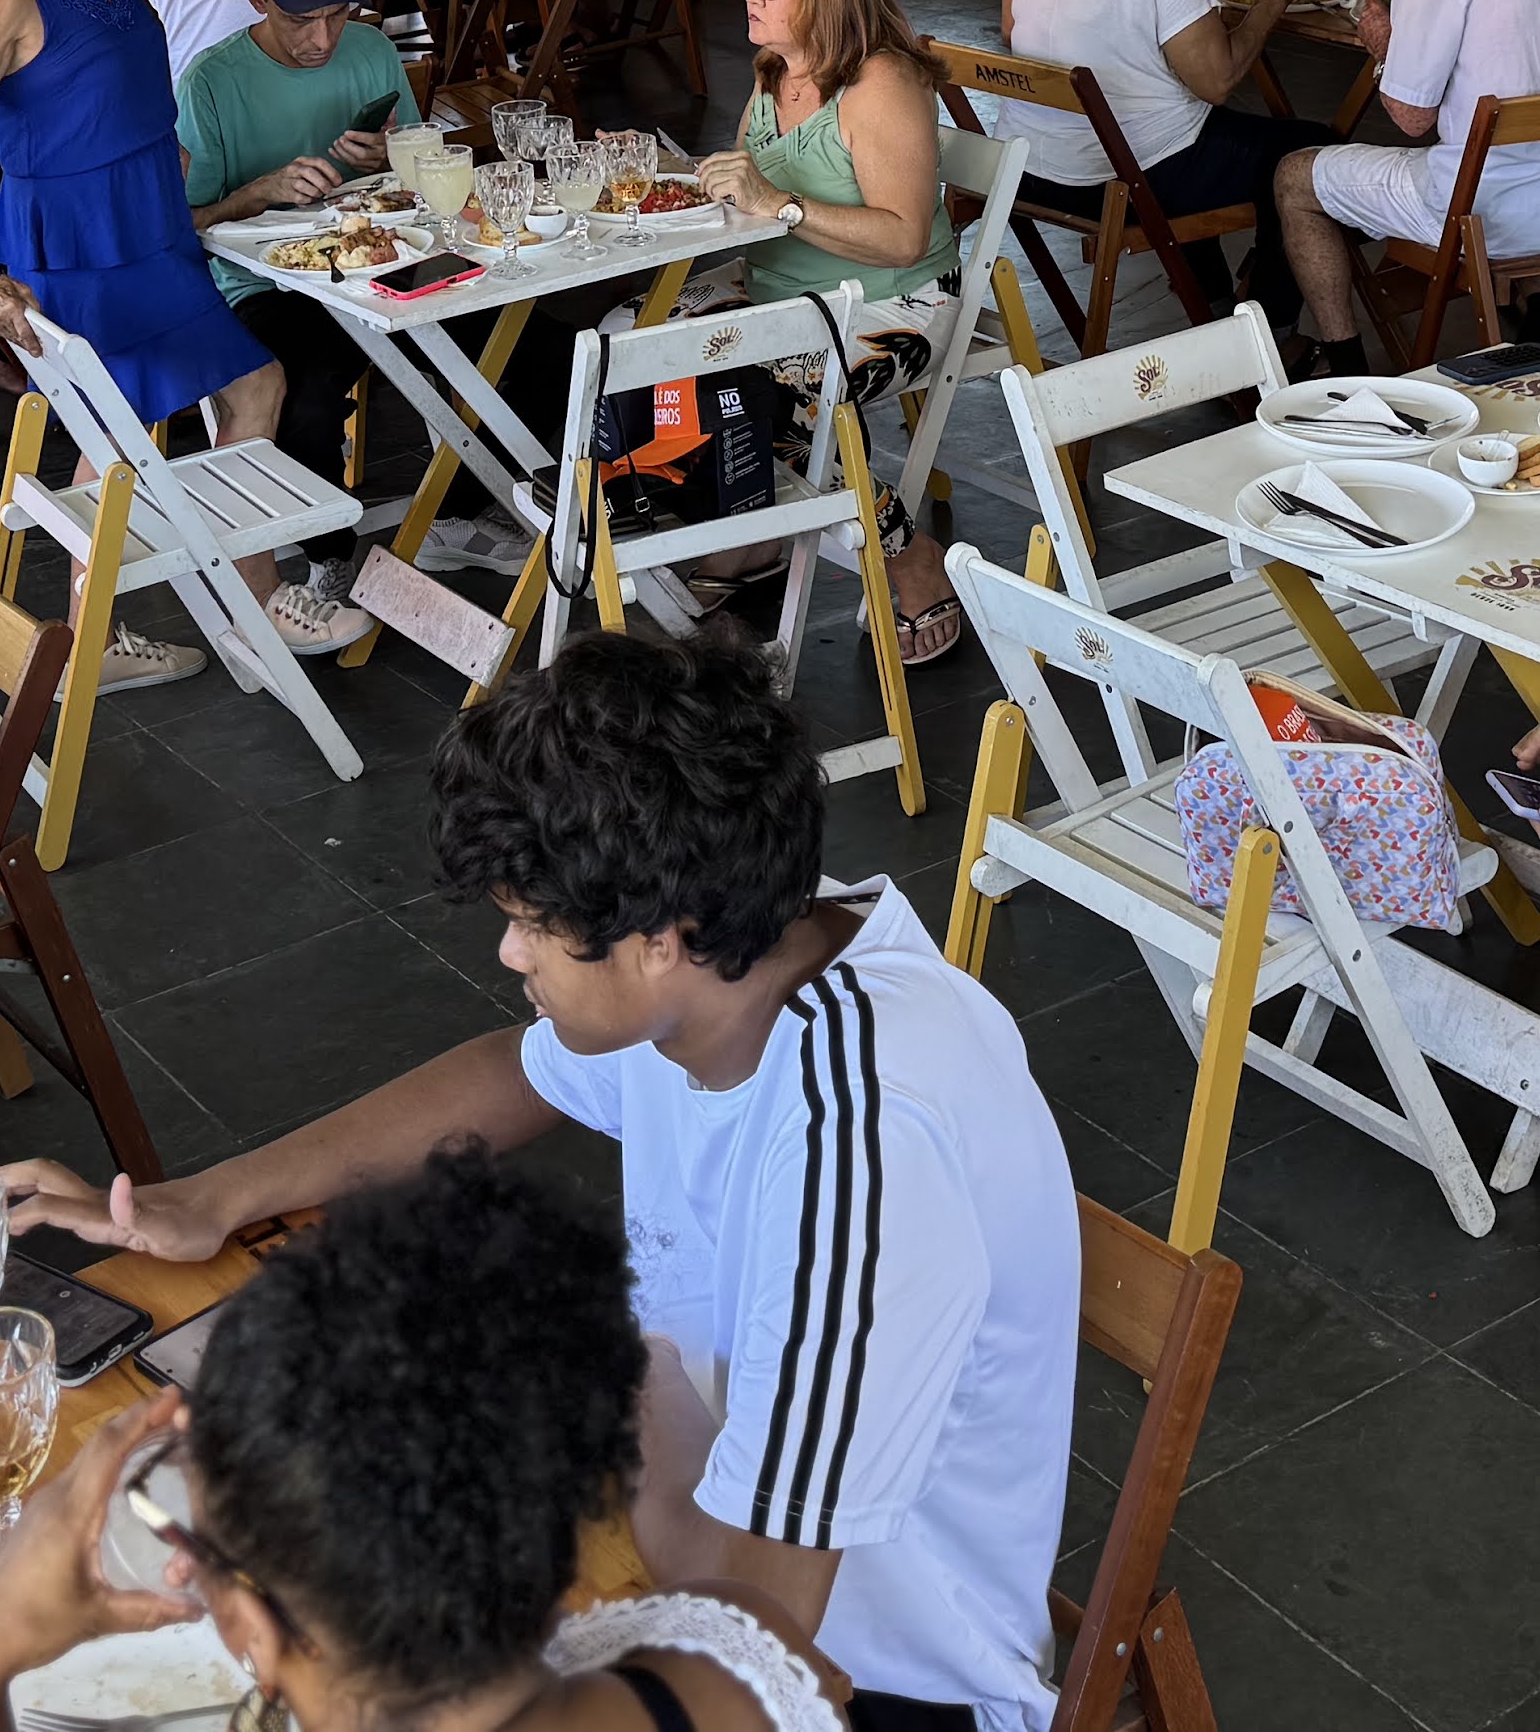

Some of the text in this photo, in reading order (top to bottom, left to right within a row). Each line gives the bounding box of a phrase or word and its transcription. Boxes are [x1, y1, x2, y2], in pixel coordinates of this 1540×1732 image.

[975, 63, 1036, 94] AMSTEL
[664, 389, 681, 405] DOS
[718, 391, 741, 409] NO
